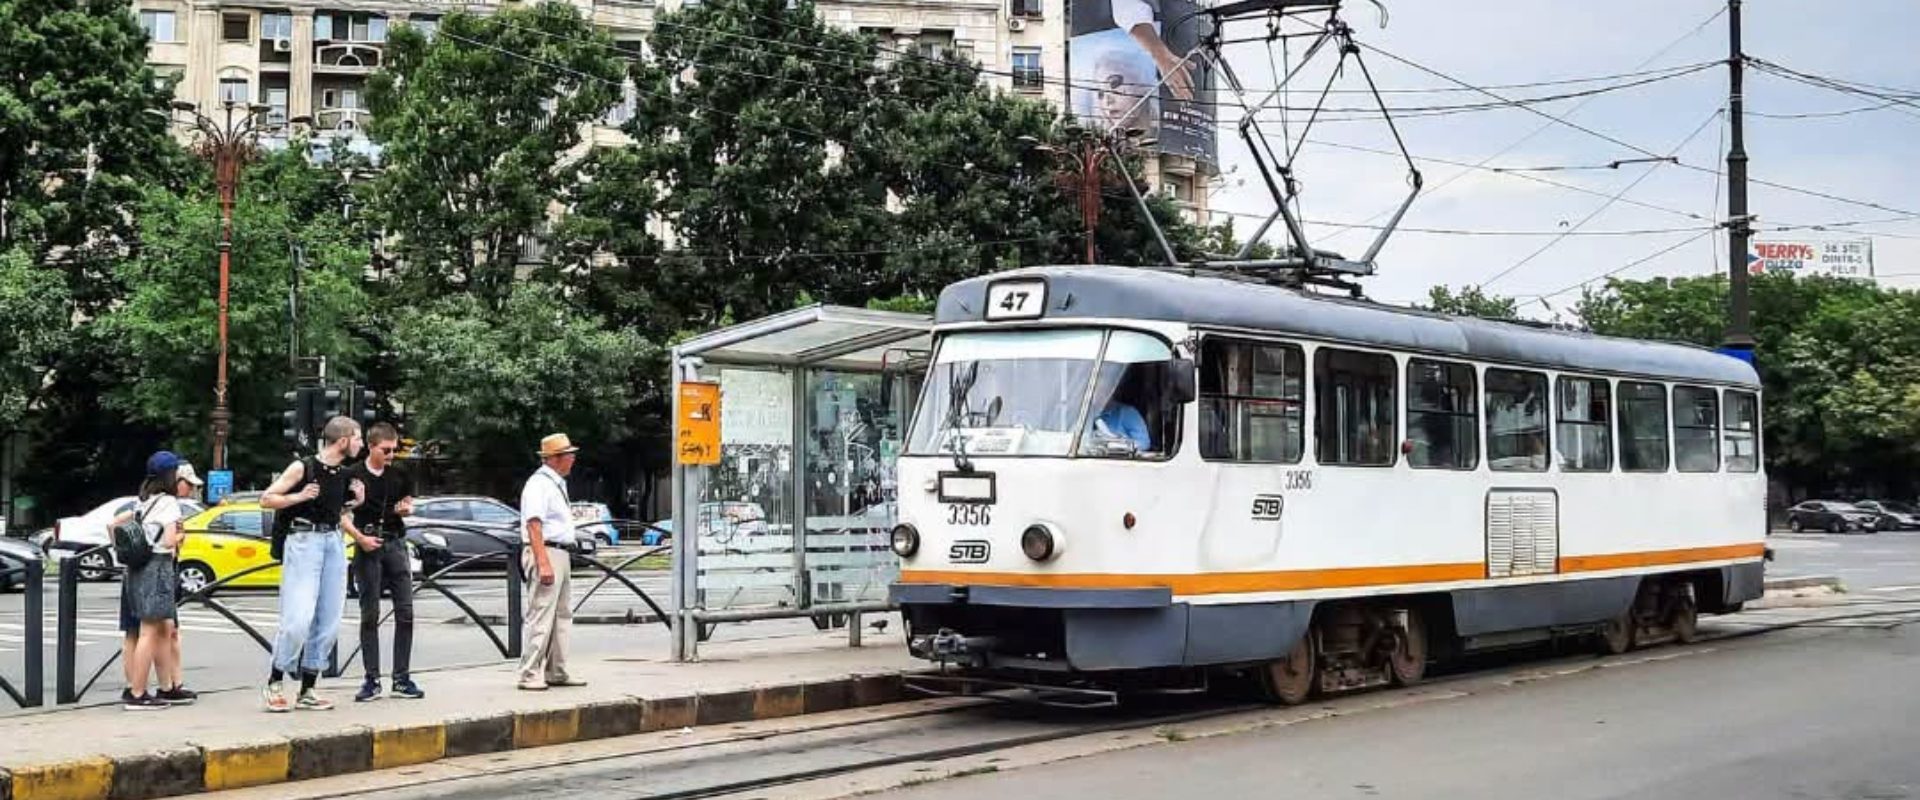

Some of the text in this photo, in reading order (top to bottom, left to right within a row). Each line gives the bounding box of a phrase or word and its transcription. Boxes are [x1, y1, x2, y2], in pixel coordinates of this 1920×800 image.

[1000, 292, 1029, 311] 47
[1285, 470, 1312, 490] 3356
[947, 504, 991, 526] 3356
[1250, 498, 1280, 516] STB
[948, 544, 987, 559] STB
